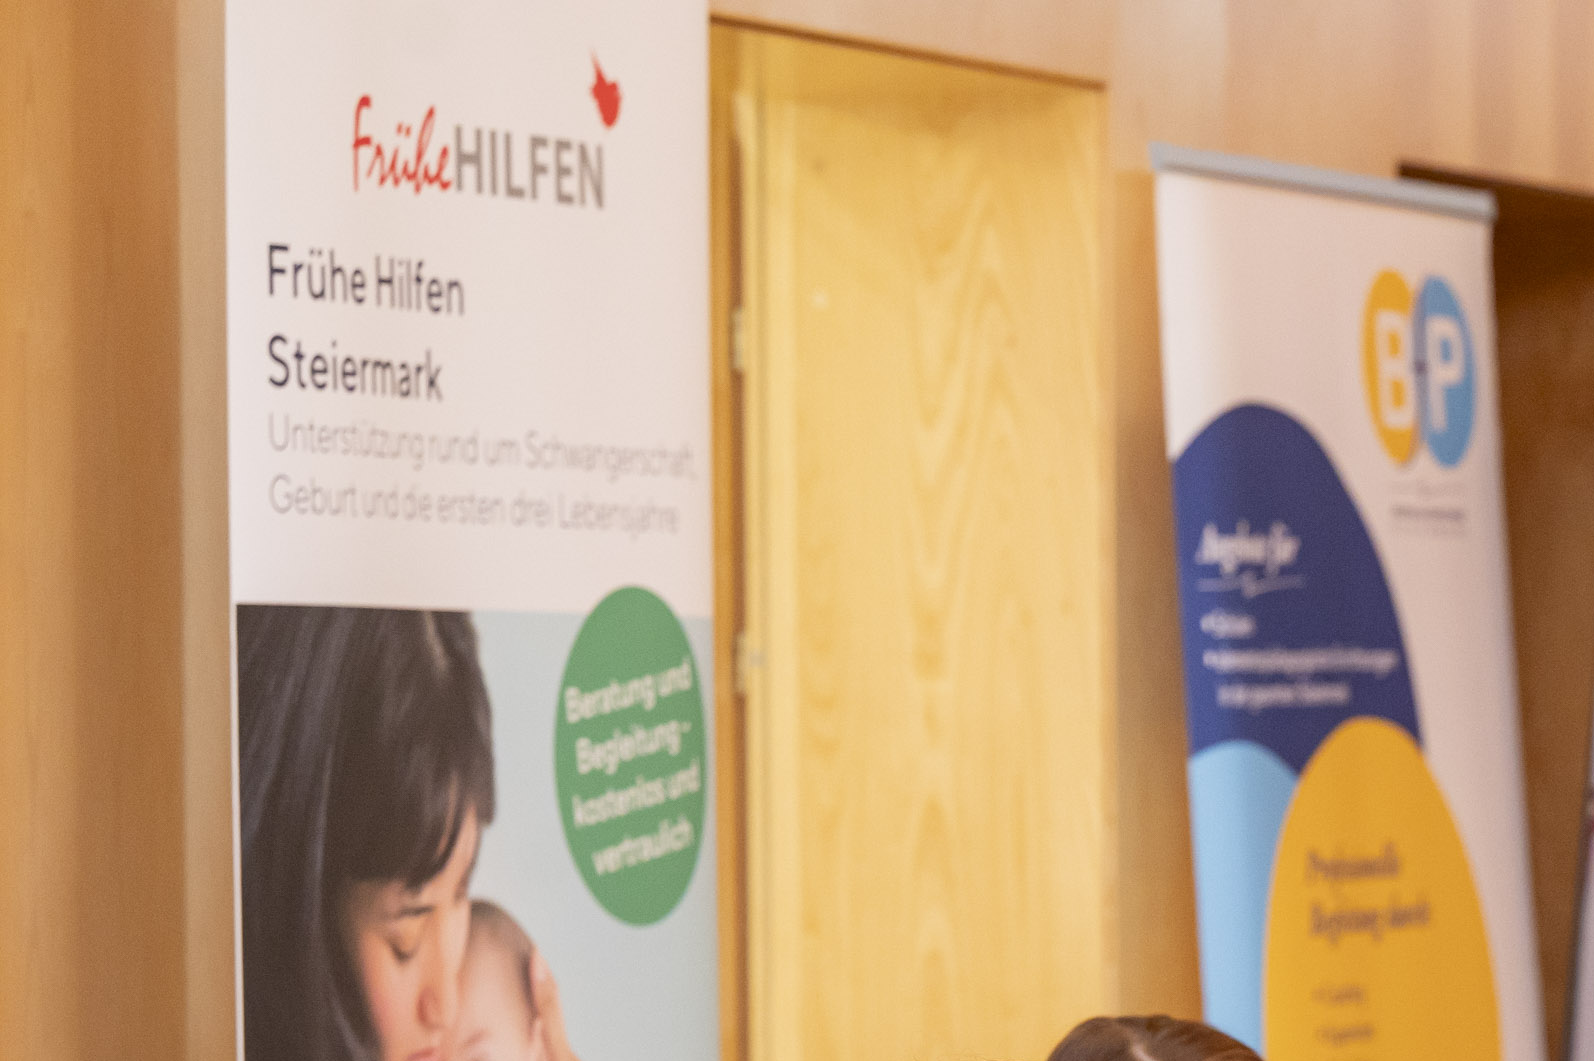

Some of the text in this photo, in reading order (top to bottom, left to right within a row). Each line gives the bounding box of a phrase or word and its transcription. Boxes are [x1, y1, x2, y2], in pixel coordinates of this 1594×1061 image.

[267, 243, 466, 316] Frühe Hilfen
[267, 334, 444, 402] Steiermark
[268, 411, 699, 483] Unterstützung rund um Schwangerschaft,
[269, 472, 681, 541] Geburt und die ersten drei Lebensjahre
[565, 655, 693, 724] Beratung und
[575, 720, 681, 775] Begleitung
[571, 756, 701, 828] kostenlos und
[592, 814, 694, 876] vertraulich
